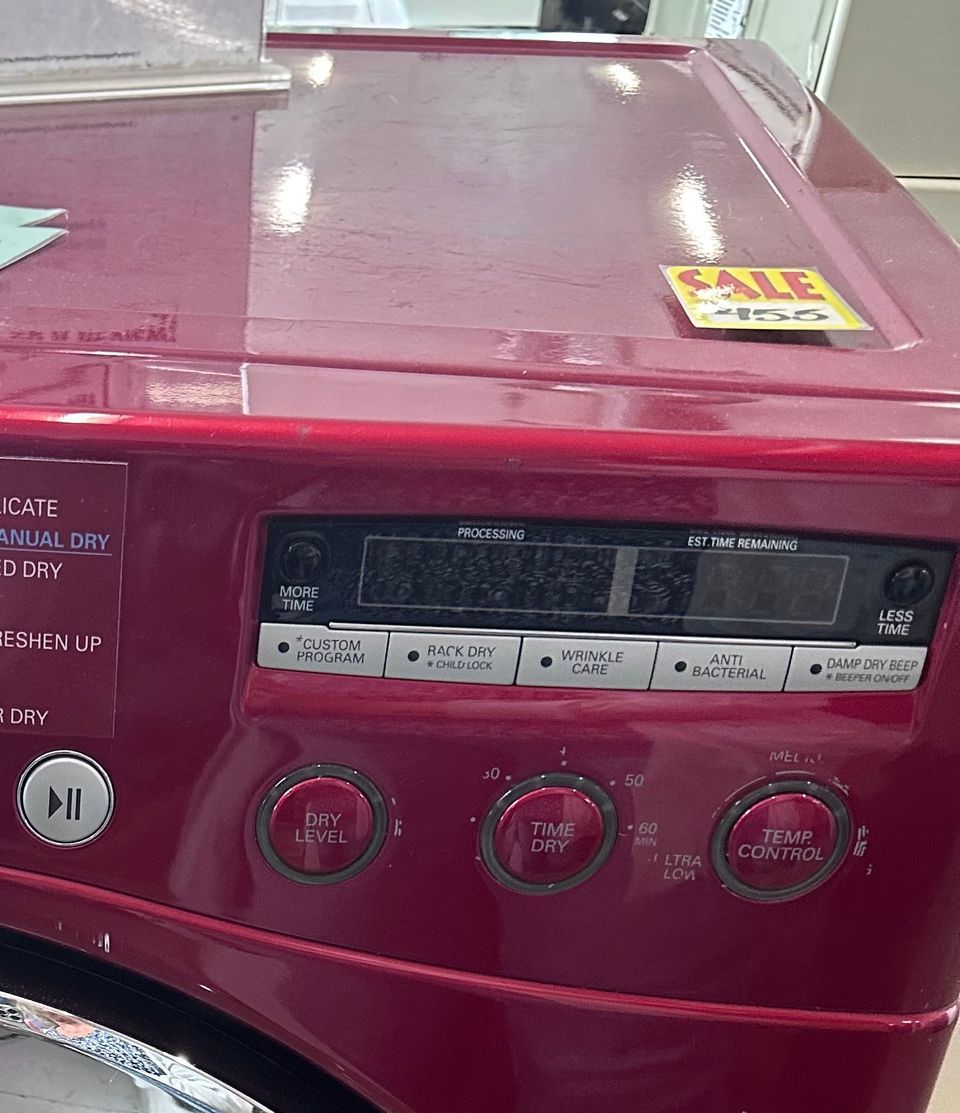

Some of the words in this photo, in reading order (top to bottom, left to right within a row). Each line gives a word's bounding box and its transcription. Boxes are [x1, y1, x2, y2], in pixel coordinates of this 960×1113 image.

[677, 268, 827, 301] SALE
[457, 527, 525, 540] PROCESSING
[70, 531, 110, 551] DRY
[737, 538, 798, 551] REMAINING
[23, 560, 63, 580] DRY
[279, 586, 319, 598] MORE
[282, 600, 313, 612] TIME
[878, 610, 914, 622] LESS
[877, 623, 910, 636] TIME
[75, 634, 102, 653] UP
[302, 638, 361, 651] CUSTOM
[296, 651, 365, 664] PROGRAM
[427, 645, 465, 657] RACK
[467, 646, 496, 658] DRY
[561, 650, 624, 663] WRINKLE
[467, 661, 493, 670] LOCK
[710, 654, 743, 666] ANTI
[826, 658, 861, 669] DAMP
[863, 659, 887, 670] DRY
[889, 660, 919, 671] BEEP
[572, 663, 609, 675] CARE
[692, 667, 767, 680] BACTERIAL
[835, 672, 872, 682] BEEPER
[10, 709, 49, 727] DRY
[624, 774, 644, 787] 50
[305, 813, 341, 827] DRY
[531, 821, 576, 837] TIME
[638, 822, 658, 835] 60
[295, 829, 348, 844] LEVEL
[634, 836, 657, 847] MIN
[762, 828, 813, 845] TEMP.
[531, 839, 570, 853] DRY
[738, 843, 825, 861] CONTROL
